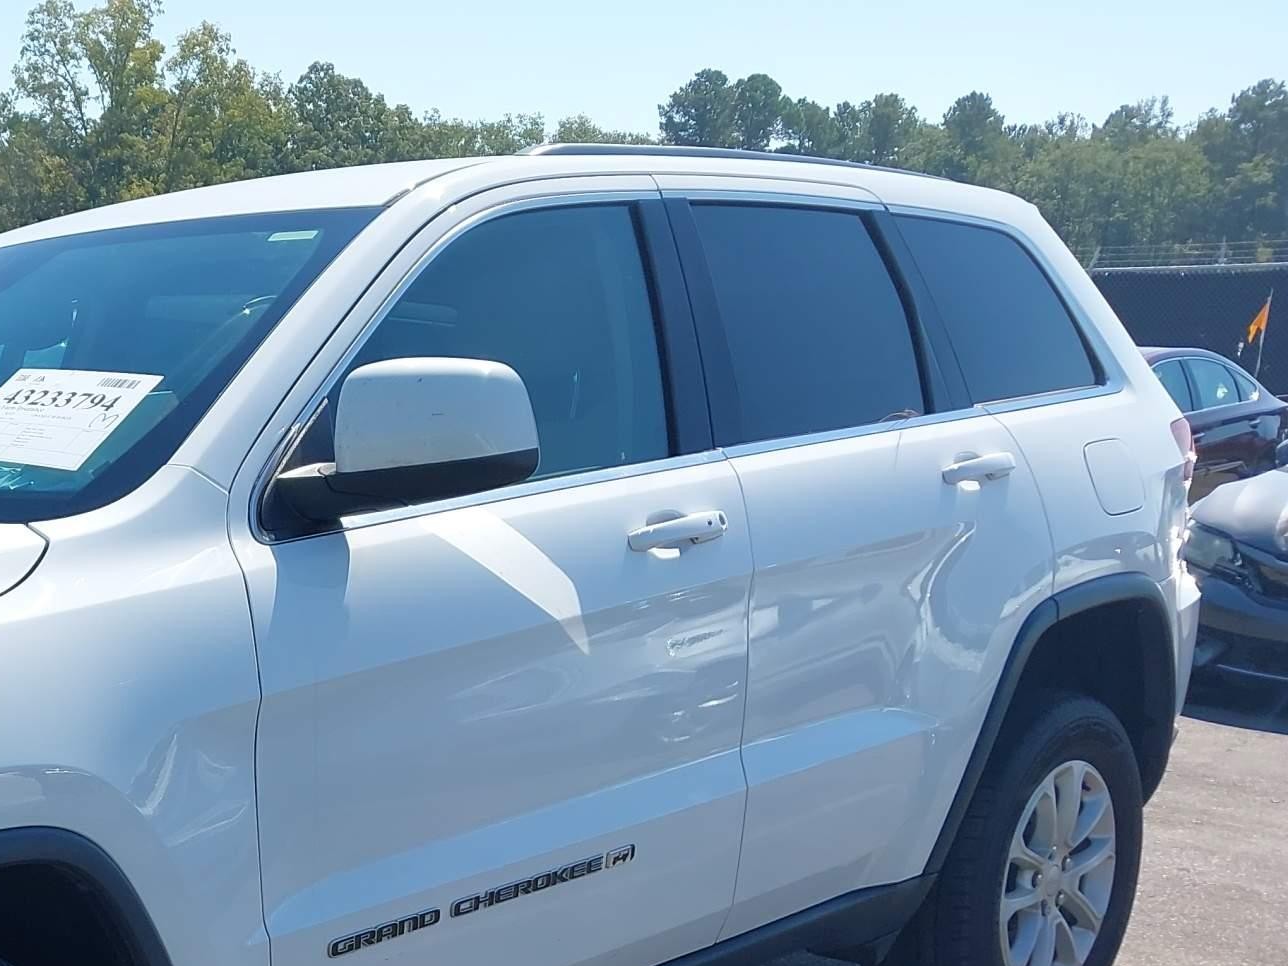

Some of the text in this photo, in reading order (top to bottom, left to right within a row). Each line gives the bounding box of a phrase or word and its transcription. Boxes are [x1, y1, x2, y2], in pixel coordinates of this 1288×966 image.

[3, 389, 122, 411] 43233794
[327, 856, 604, 959] GRAND CHEROKEE
